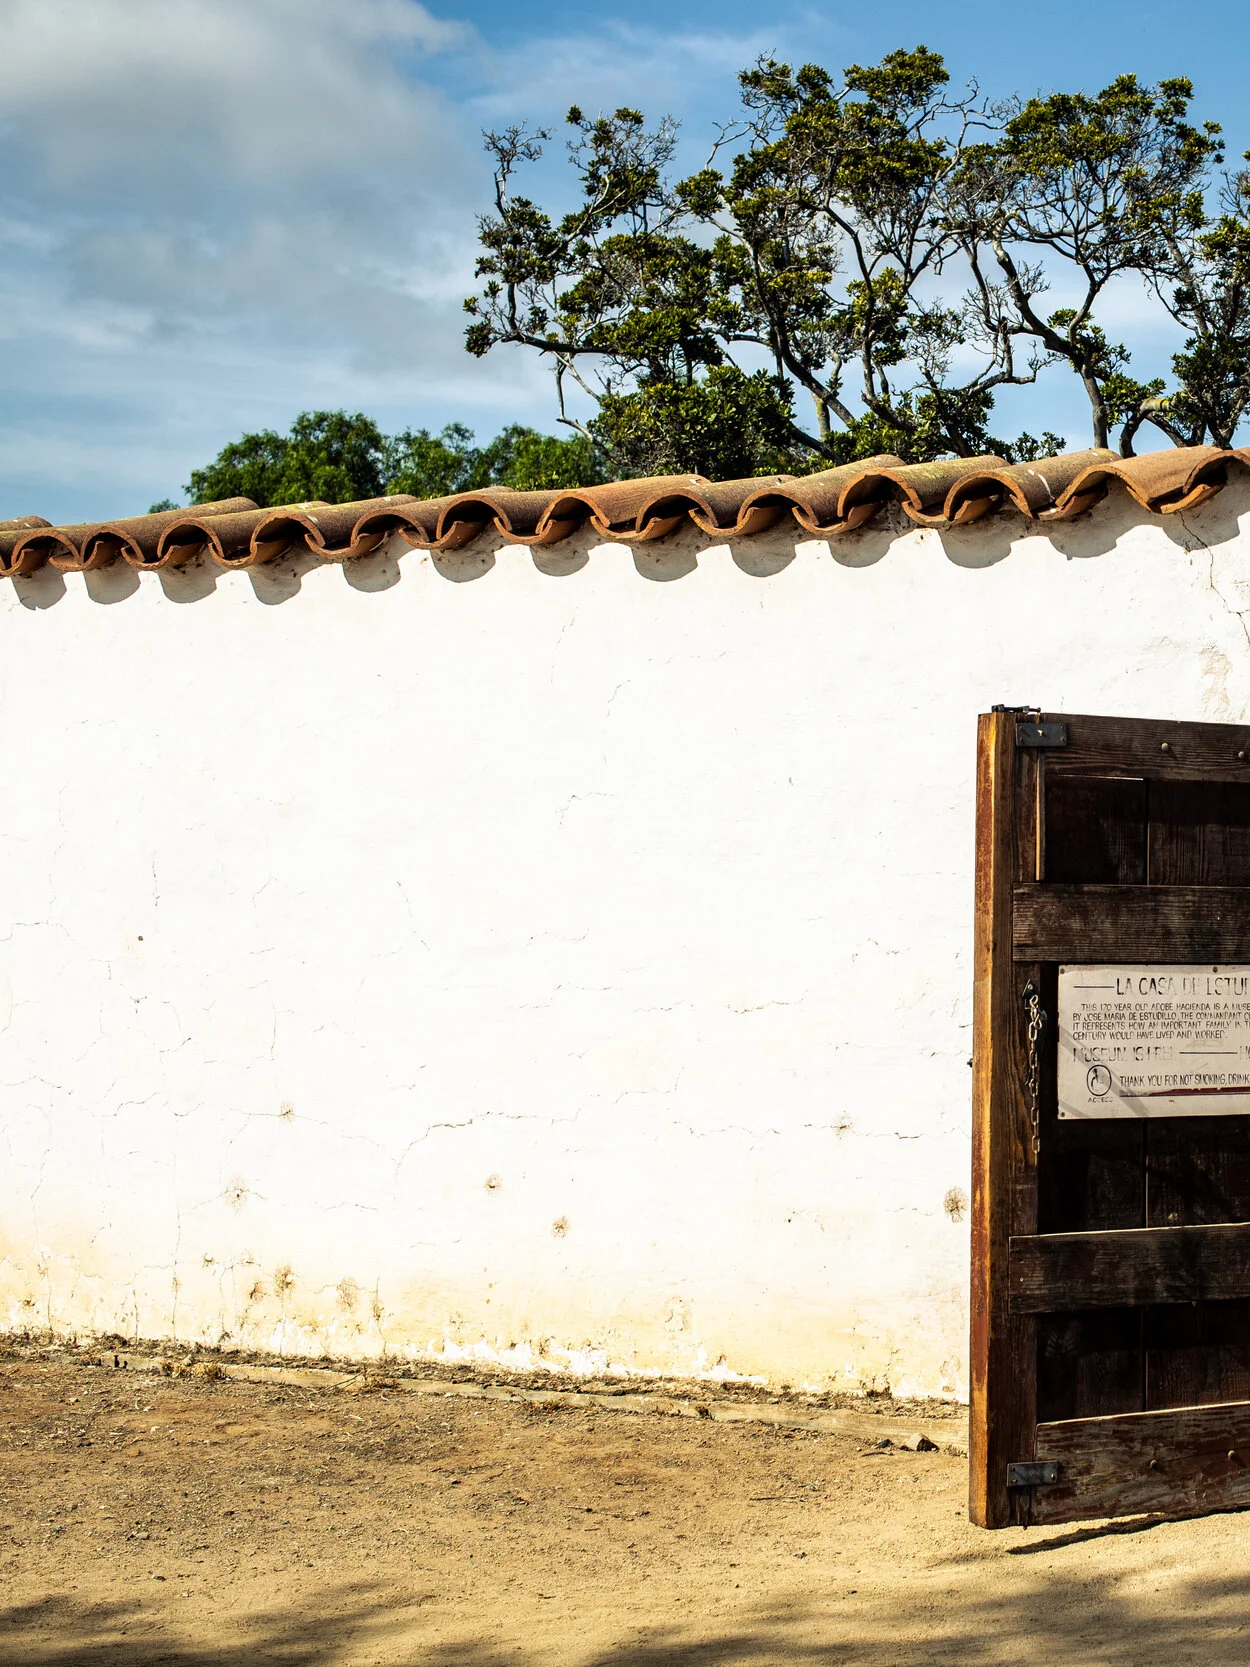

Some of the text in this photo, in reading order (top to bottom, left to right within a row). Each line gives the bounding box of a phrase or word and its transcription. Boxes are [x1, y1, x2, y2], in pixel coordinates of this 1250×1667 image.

[1116, 977, 1132, 995] LA
[1138, 977, 1177, 995] CASA
[1081, 1003, 1097, 1011] THIS
[1114, 1003, 1132, 1011] YEAR
[1135, 1003, 1149, 1011] OLD
[1151, 1003, 1173, 1011] ADOBE
[1176, 1003, 1211, 1011] HACIENDA
[1214, 1003, 1221, 1011] IS
[1223, 1003, 1229, 1011] A
[1072, 1012, 1082, 1021] BY
[1083, 1012, 1102, 1021] JOSE
[1104, 1012, 1126, 1021] MARIA
[1128, 1012, 1138, 1021] DE
[1181, 1012, 1194, 1021] THE
[1072, 1022, 1080, 1030] IT
[1082, 1022, 1126, 1030] REPRESENTS
[1128, 1022, 1145, 1030] HOW
[1148, 1022, 1158, 1030] AN
[1161, 1022, 1202, 1030] IMPORTANT
[1206, 1021, 1232, 1029] FAMILY
[1235, 1021, 1242, 1029] IN
[1072, 1031, 1107, 1040] CENTURY
[1109, 1031, 1134, 1040] WOULD
[1136, 1031, 1154, 1040] HAVE
[1155, 1031, 1175, 1040] LIVED
[1176, 1031, 1192, 1040] AND
[1133, 1046, 1144, 1061] IS
[1119, 1075, 1145, 1087] THANK
[1147, 1075, 1162, 1087] YOU
[1164, 1075, 1178, 1086] FOR
[1179, 1074, 1193, 1086] NOT
